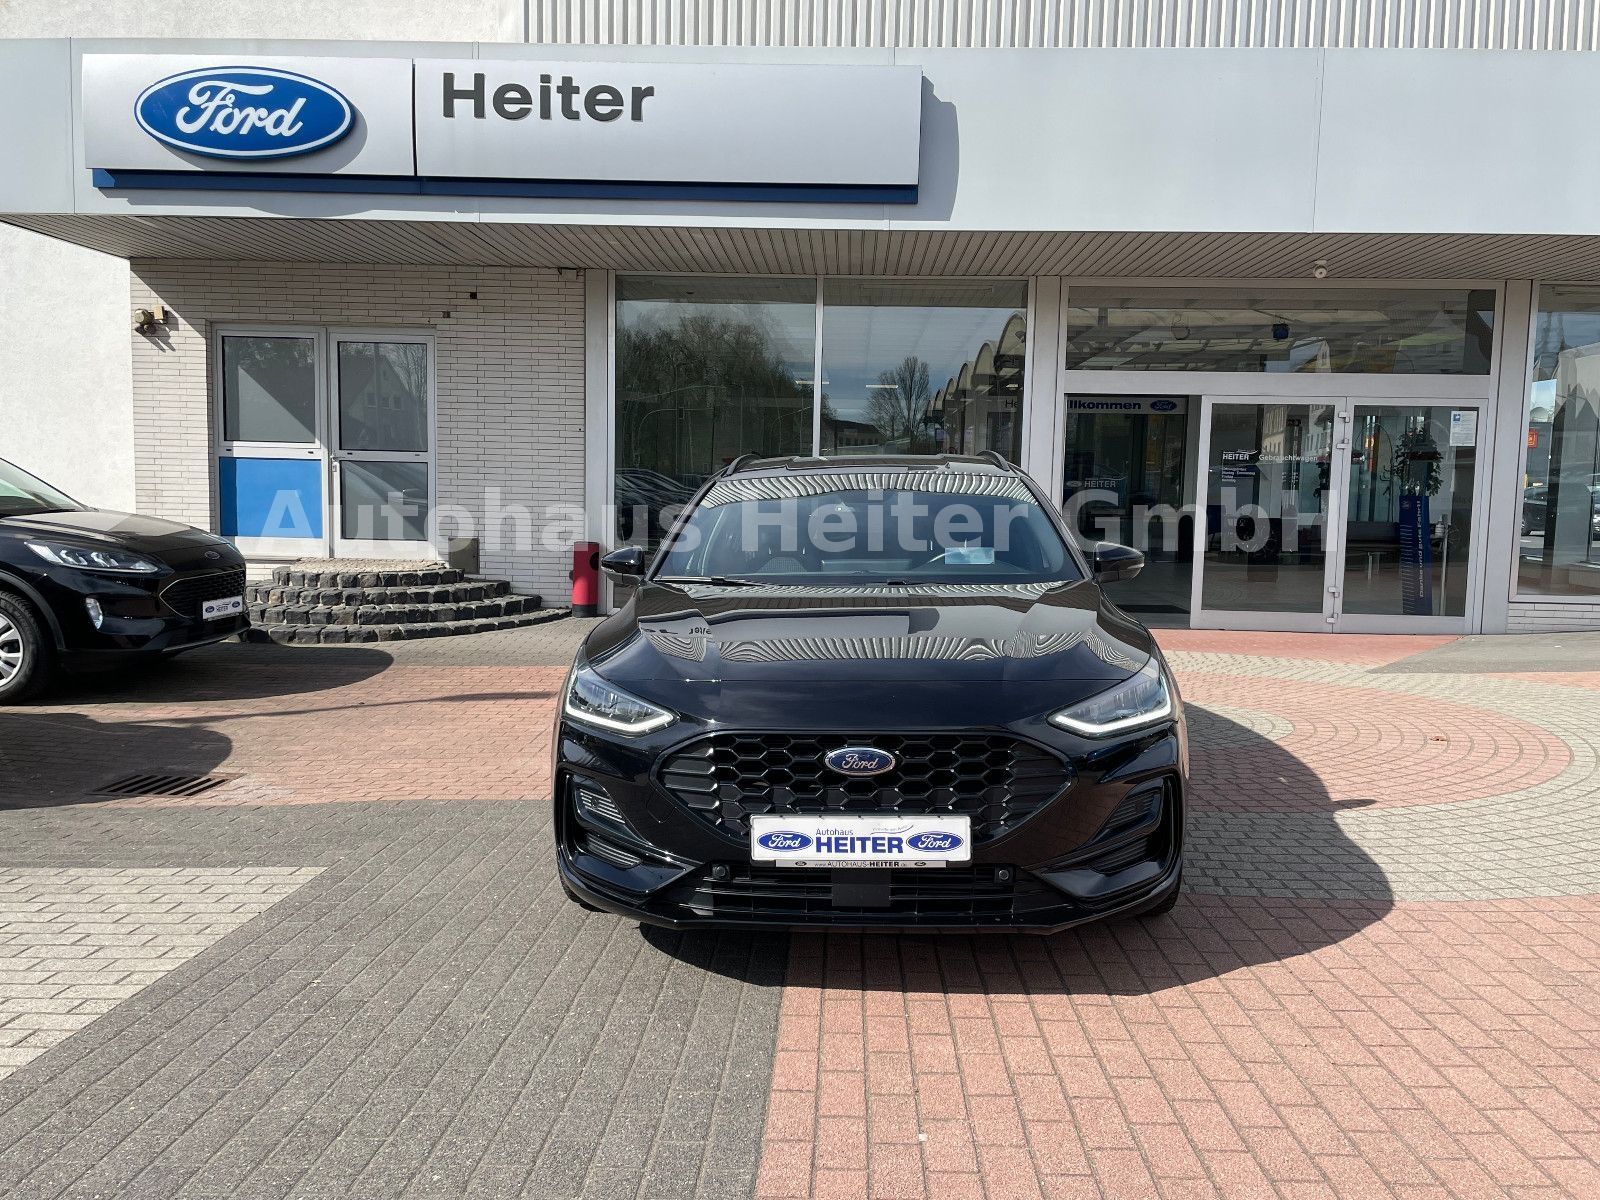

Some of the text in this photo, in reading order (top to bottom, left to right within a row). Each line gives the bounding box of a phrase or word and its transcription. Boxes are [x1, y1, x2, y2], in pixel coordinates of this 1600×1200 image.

[441, 72, 655, 123] Heiter
[175, 80, 307, 138] Ford
[1222, 453, 1318, 463] HEITER Gebrauchtwagen
[1084, 480, 1116, 488] HEITER
[815, 828, 854, 837] Autohaus
[815, 836, 904, 854] HEITER
